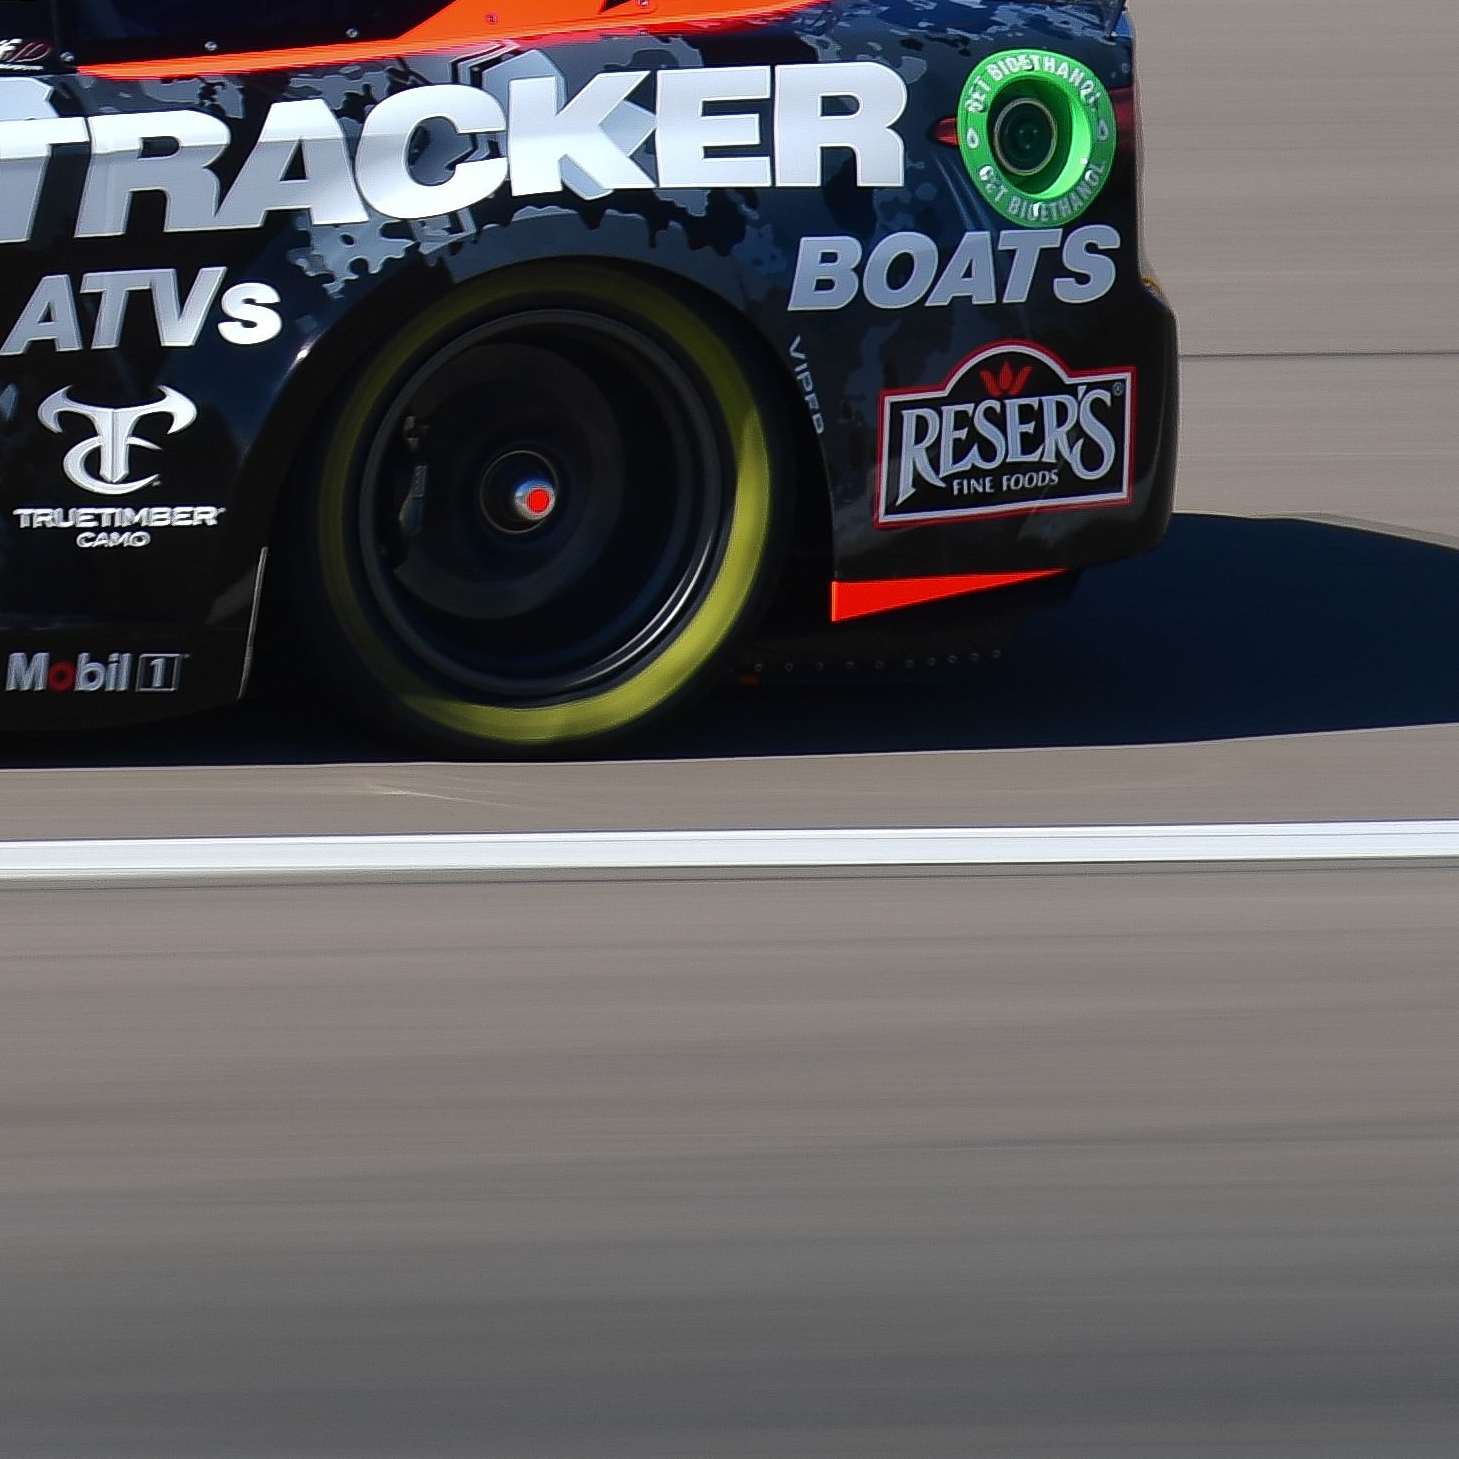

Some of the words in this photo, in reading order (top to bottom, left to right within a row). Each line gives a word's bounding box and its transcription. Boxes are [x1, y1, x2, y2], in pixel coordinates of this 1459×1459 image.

[787, 223, 1122, 312] BOATS
[895, 385, 1116, 507] RESER'S
[952, 475, 995, 496] FINE
[1001, 469, 1060, 492] FOODS
[12, 505, 219, 529] TRUETIMBER
[75, 531, 152, 548] CAMO
[5, 652, 133, 692] Mobil
